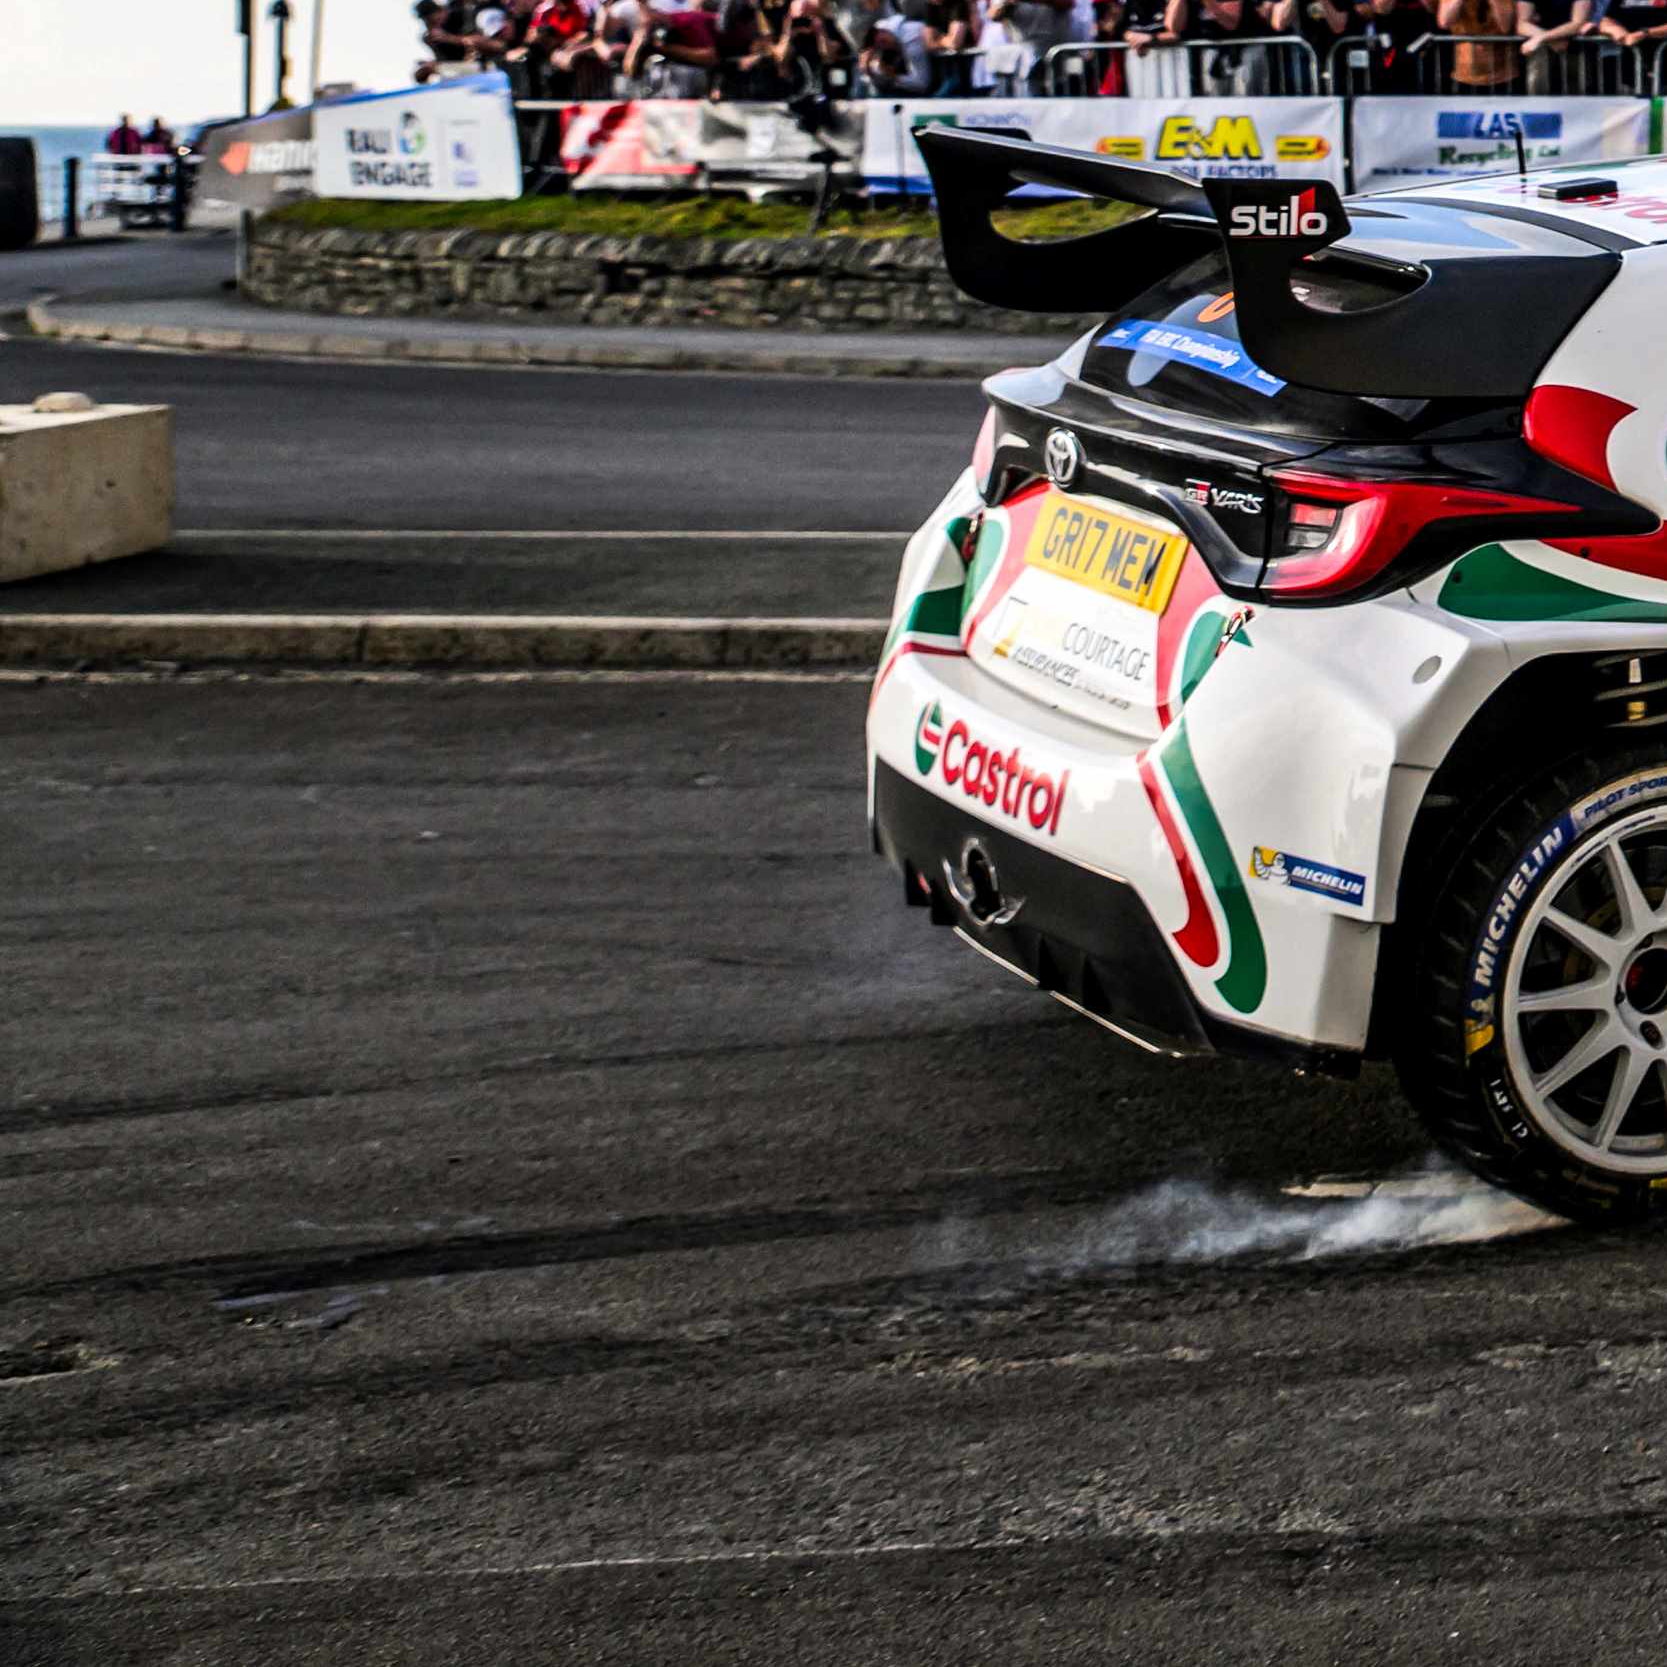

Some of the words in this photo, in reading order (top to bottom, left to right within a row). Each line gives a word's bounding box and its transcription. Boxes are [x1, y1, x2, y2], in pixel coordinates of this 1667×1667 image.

[1155, 115, 1262, 160] E&M
[351, 161, 431, 187] ENGAGE
[1229, 195, 1328, 236] Stilo
[1042, 506, 1109, 575] GR17
[942, 718, 1071, 836] Castrol
[1583, 789, 1626, 819] PILOT
[1290, 865, 1364, 895] MICHELIN
[1473, 826, 1563, 988] MICHELIN
